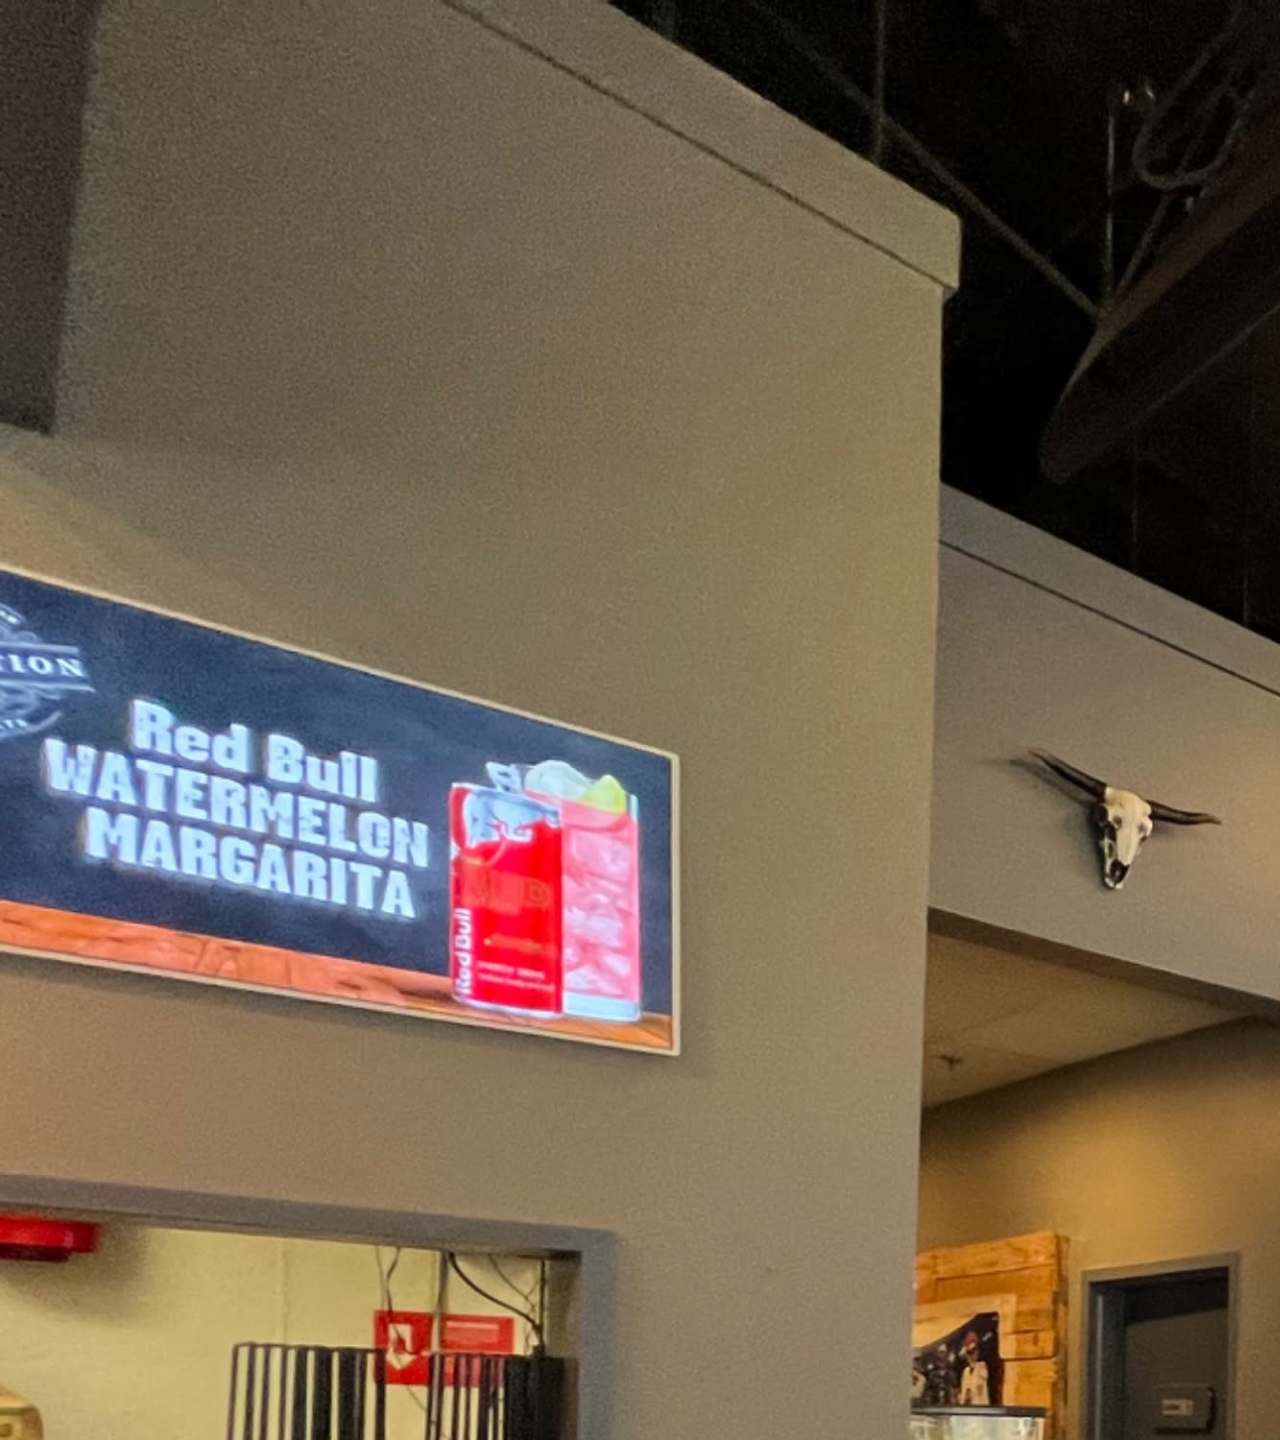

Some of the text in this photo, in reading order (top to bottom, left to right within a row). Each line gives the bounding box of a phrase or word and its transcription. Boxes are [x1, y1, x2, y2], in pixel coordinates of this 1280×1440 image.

[43, 737, 429, 868] WATERMELON
[131, 699, 378, 803] Red Bull
[84, 806, 416, 919] MARGARITA
